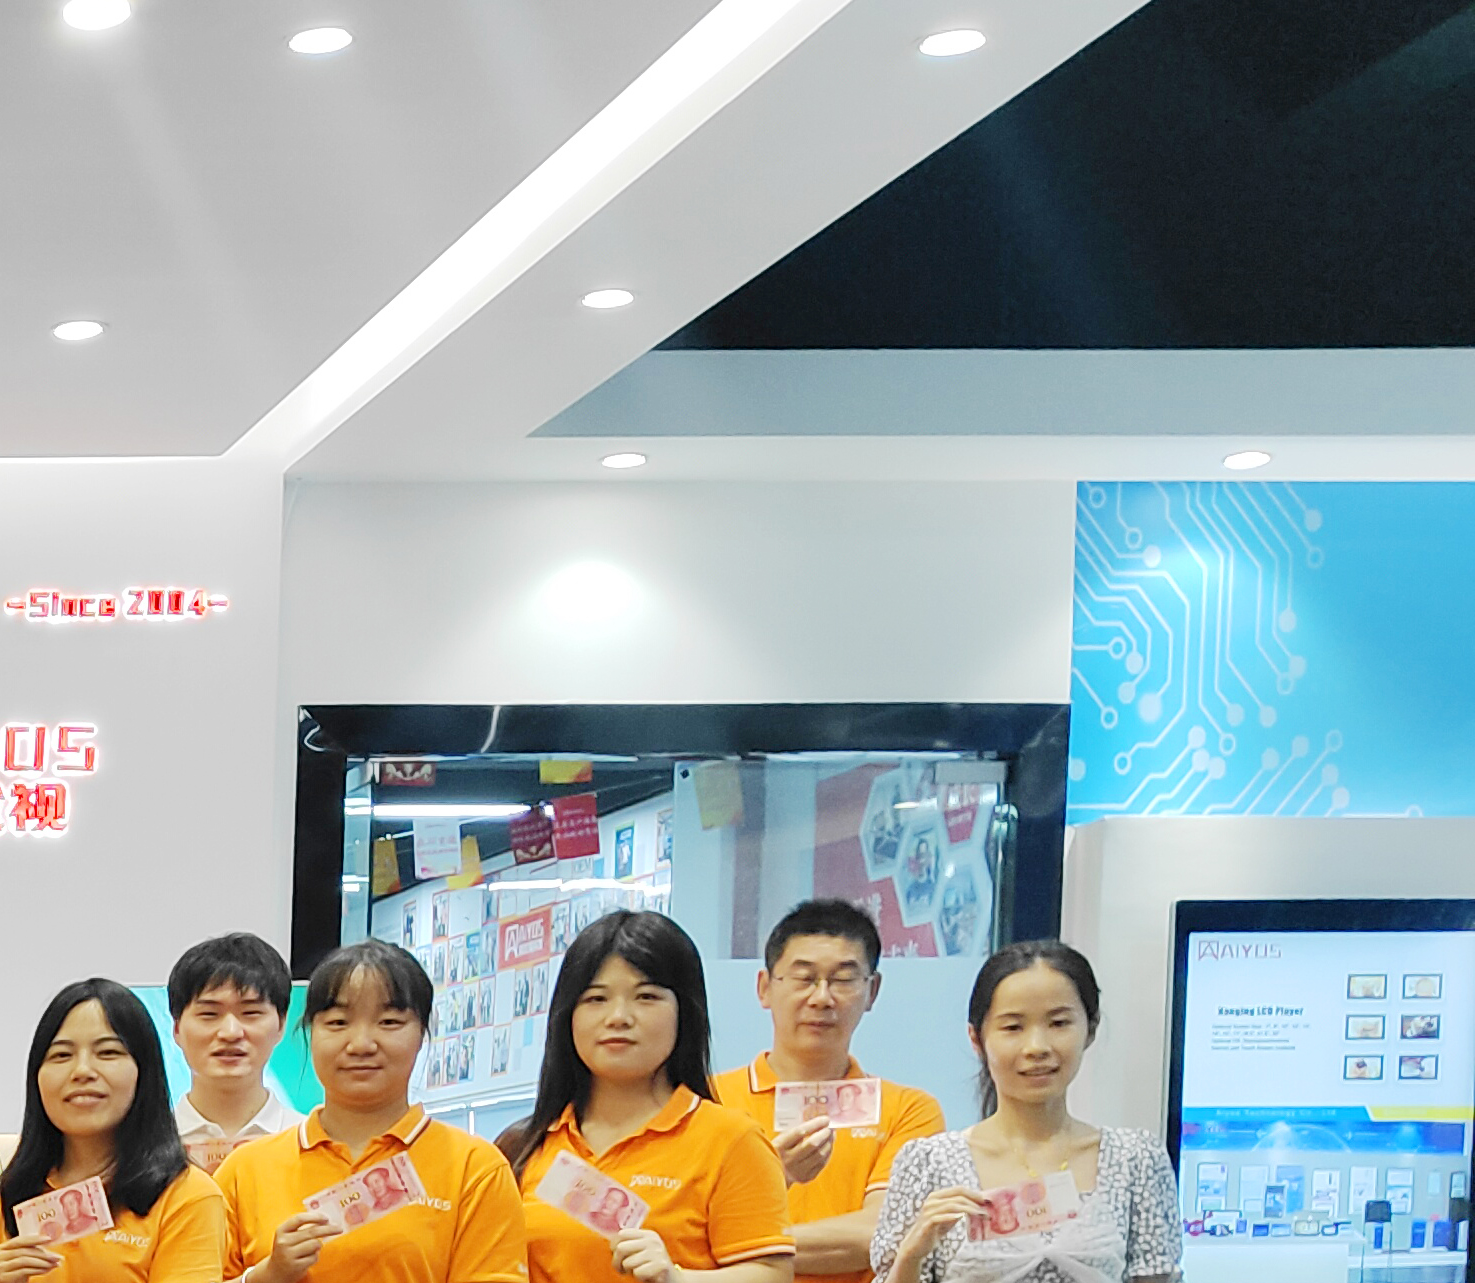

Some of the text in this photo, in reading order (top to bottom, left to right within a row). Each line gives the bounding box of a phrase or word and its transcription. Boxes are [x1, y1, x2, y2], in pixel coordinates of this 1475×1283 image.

[127, 590, 207, 616] 2004
[1220, 943, 1282, 959] AIYOS
[339, 1192, 361, 1208] 100
[37, 1208, 56, 1222] 100
